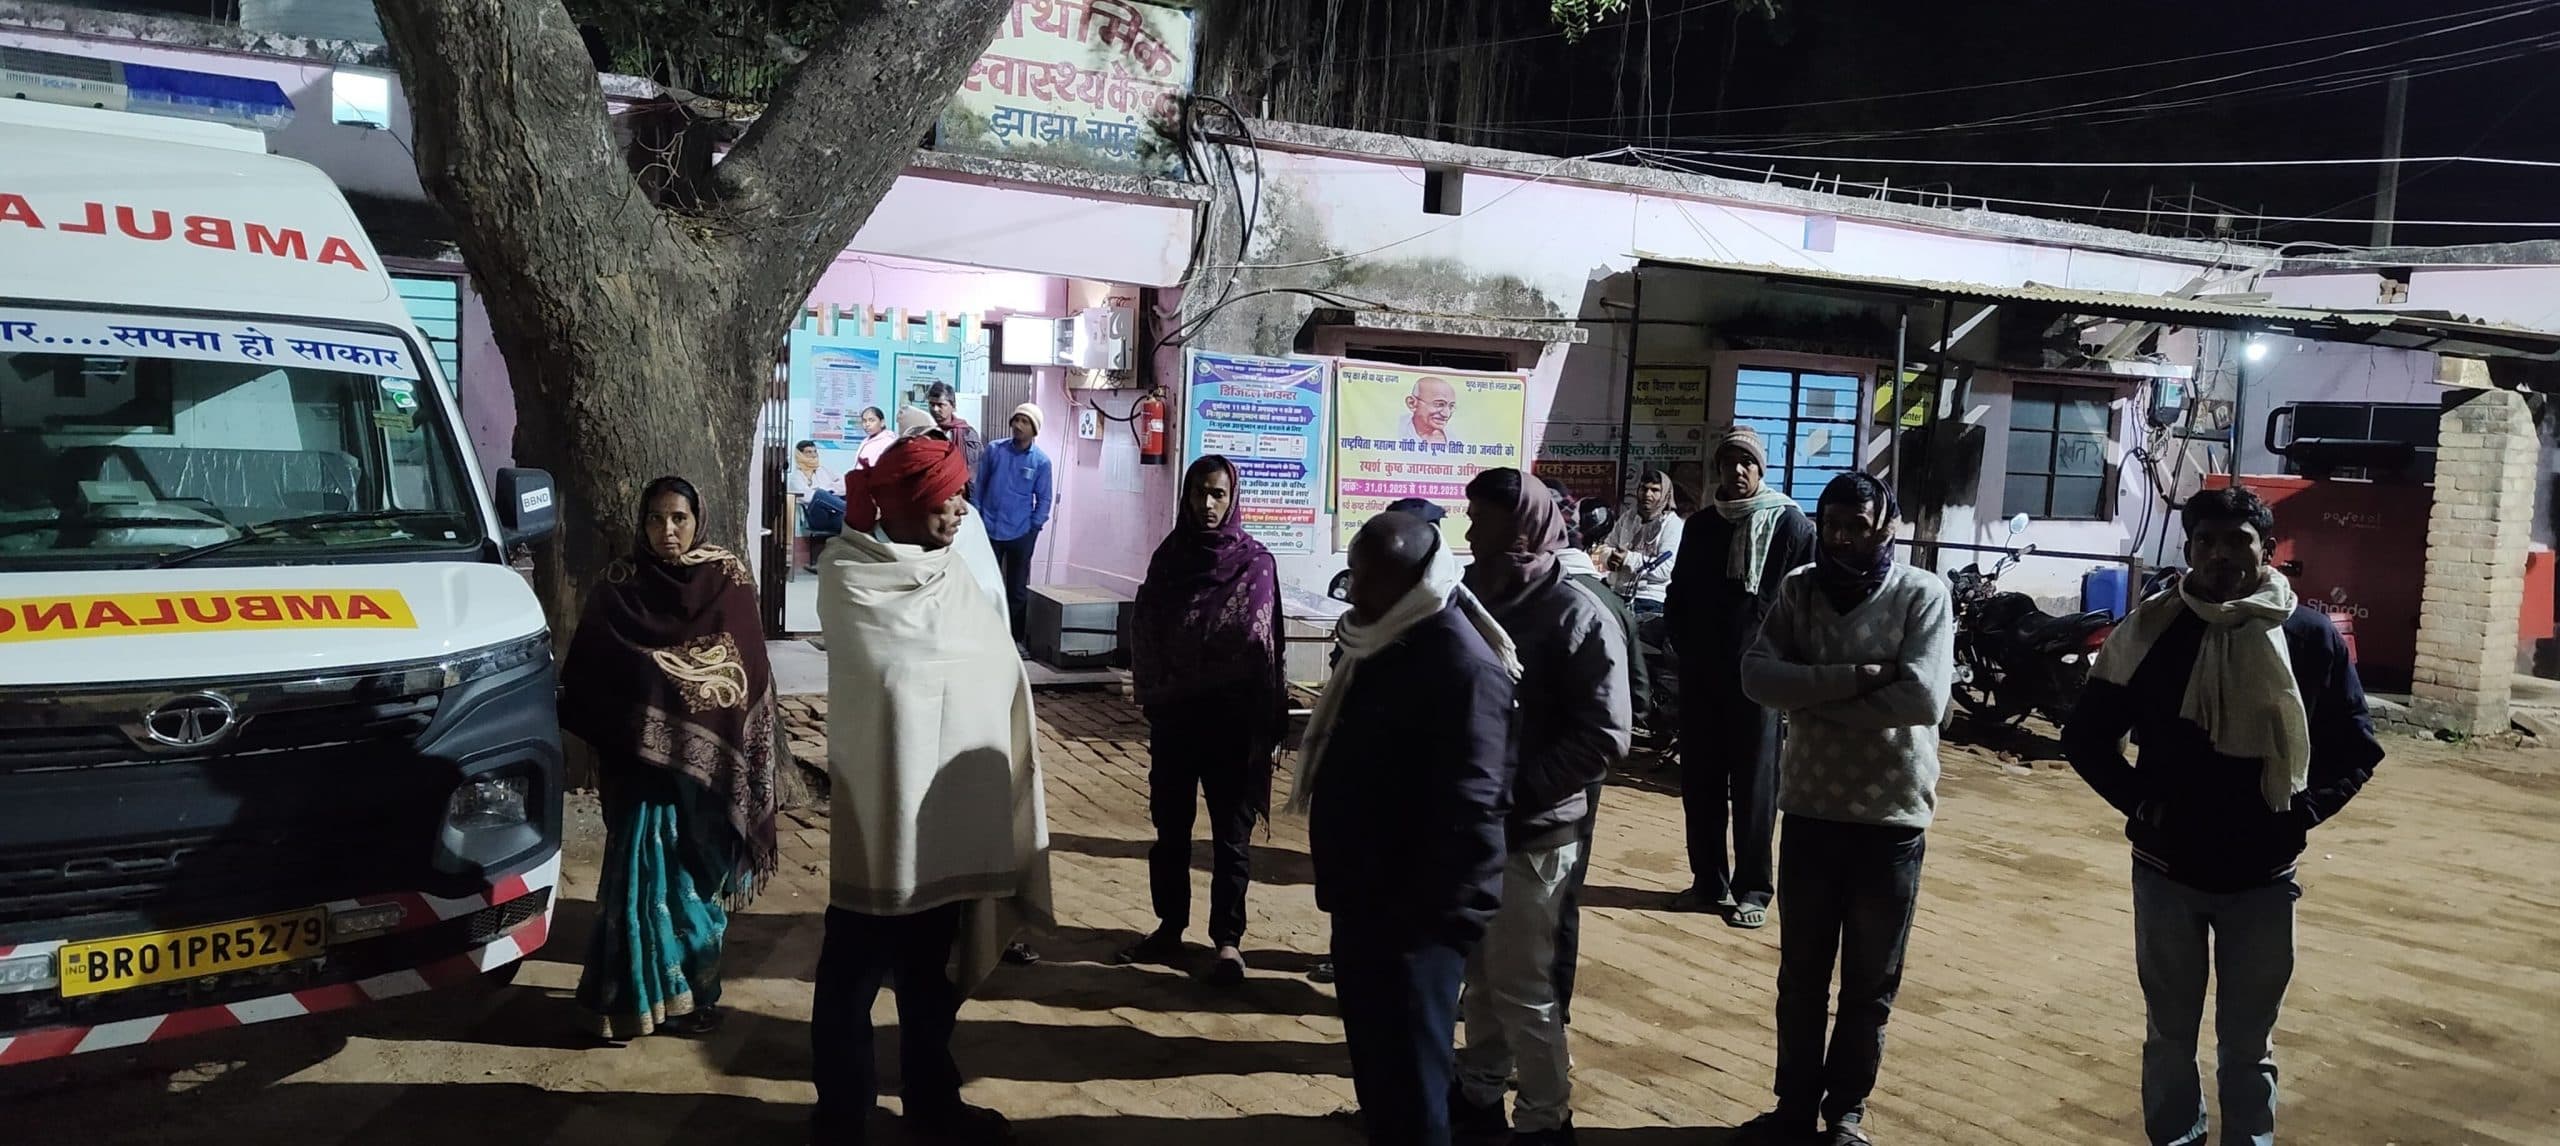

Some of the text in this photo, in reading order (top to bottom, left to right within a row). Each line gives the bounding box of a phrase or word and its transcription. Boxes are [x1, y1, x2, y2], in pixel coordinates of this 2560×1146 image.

[990, 105, 1138, 158] झाझा जमुई
[234, 327, 274, 362] हो
[287, 338, 403, 370] साकार
[1220, 384, 1260, 397] डिजिटल
[1341, 436, 1371, 451] राष्ट्रपिता
[1374, 440, 1396, 451] महात्मा
[1418, 440, 1428, 452] की
[1449, 441, 1464, 454] तिथि
[1467, 445, 1476, 454] 30
[1480, 443, 1503, 456] जनवरी
[1505, 444, 1515, 456] को
[1549, 443, 1610, 457] फाइलेरिया
[1649, 443, 1697, 457] अभियान
[1384, 463, 1403, 476] कुष्ठ
[1364, 483, 1408, 494] 31.01.2025
[1409, 483, 1415, 494] से
[1419, 485, 1458, 496] 13.02.2025
[524, 493, 549, 507] BBND
[88, 917, 322, 983] BR01PR5279
[65, 964, 87, 976] IND
